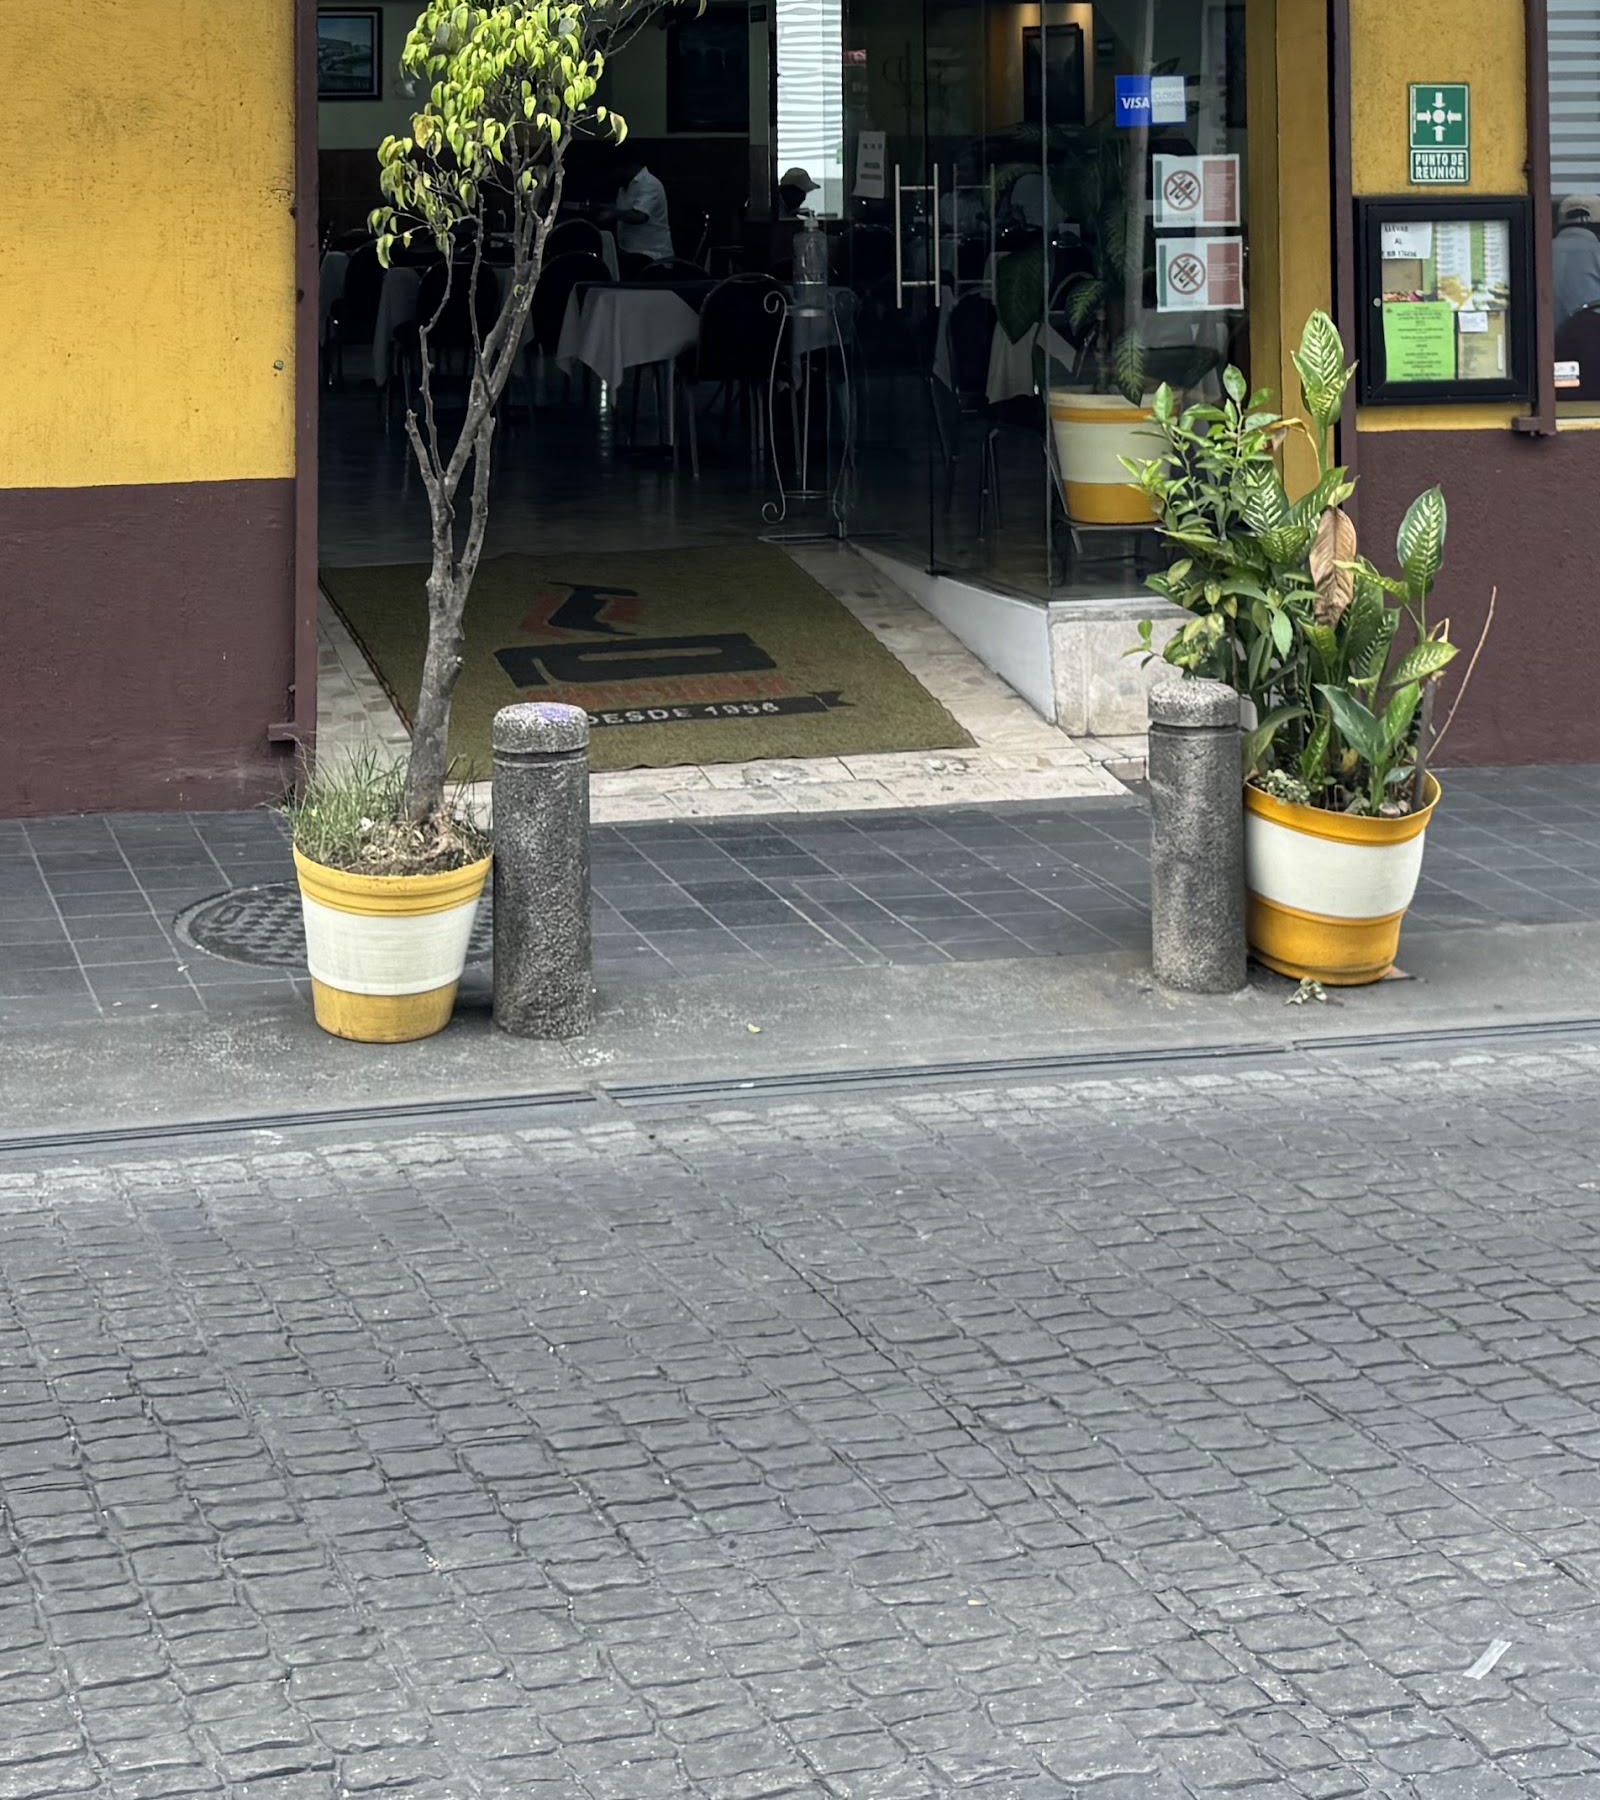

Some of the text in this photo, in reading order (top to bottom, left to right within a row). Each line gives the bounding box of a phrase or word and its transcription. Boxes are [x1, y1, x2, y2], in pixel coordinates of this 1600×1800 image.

[1121, 96, 1150, 110] VISA
[1415, 153, 1464, 166] PUNTO DE
[1415, 166, 1465, 179] REUNION
